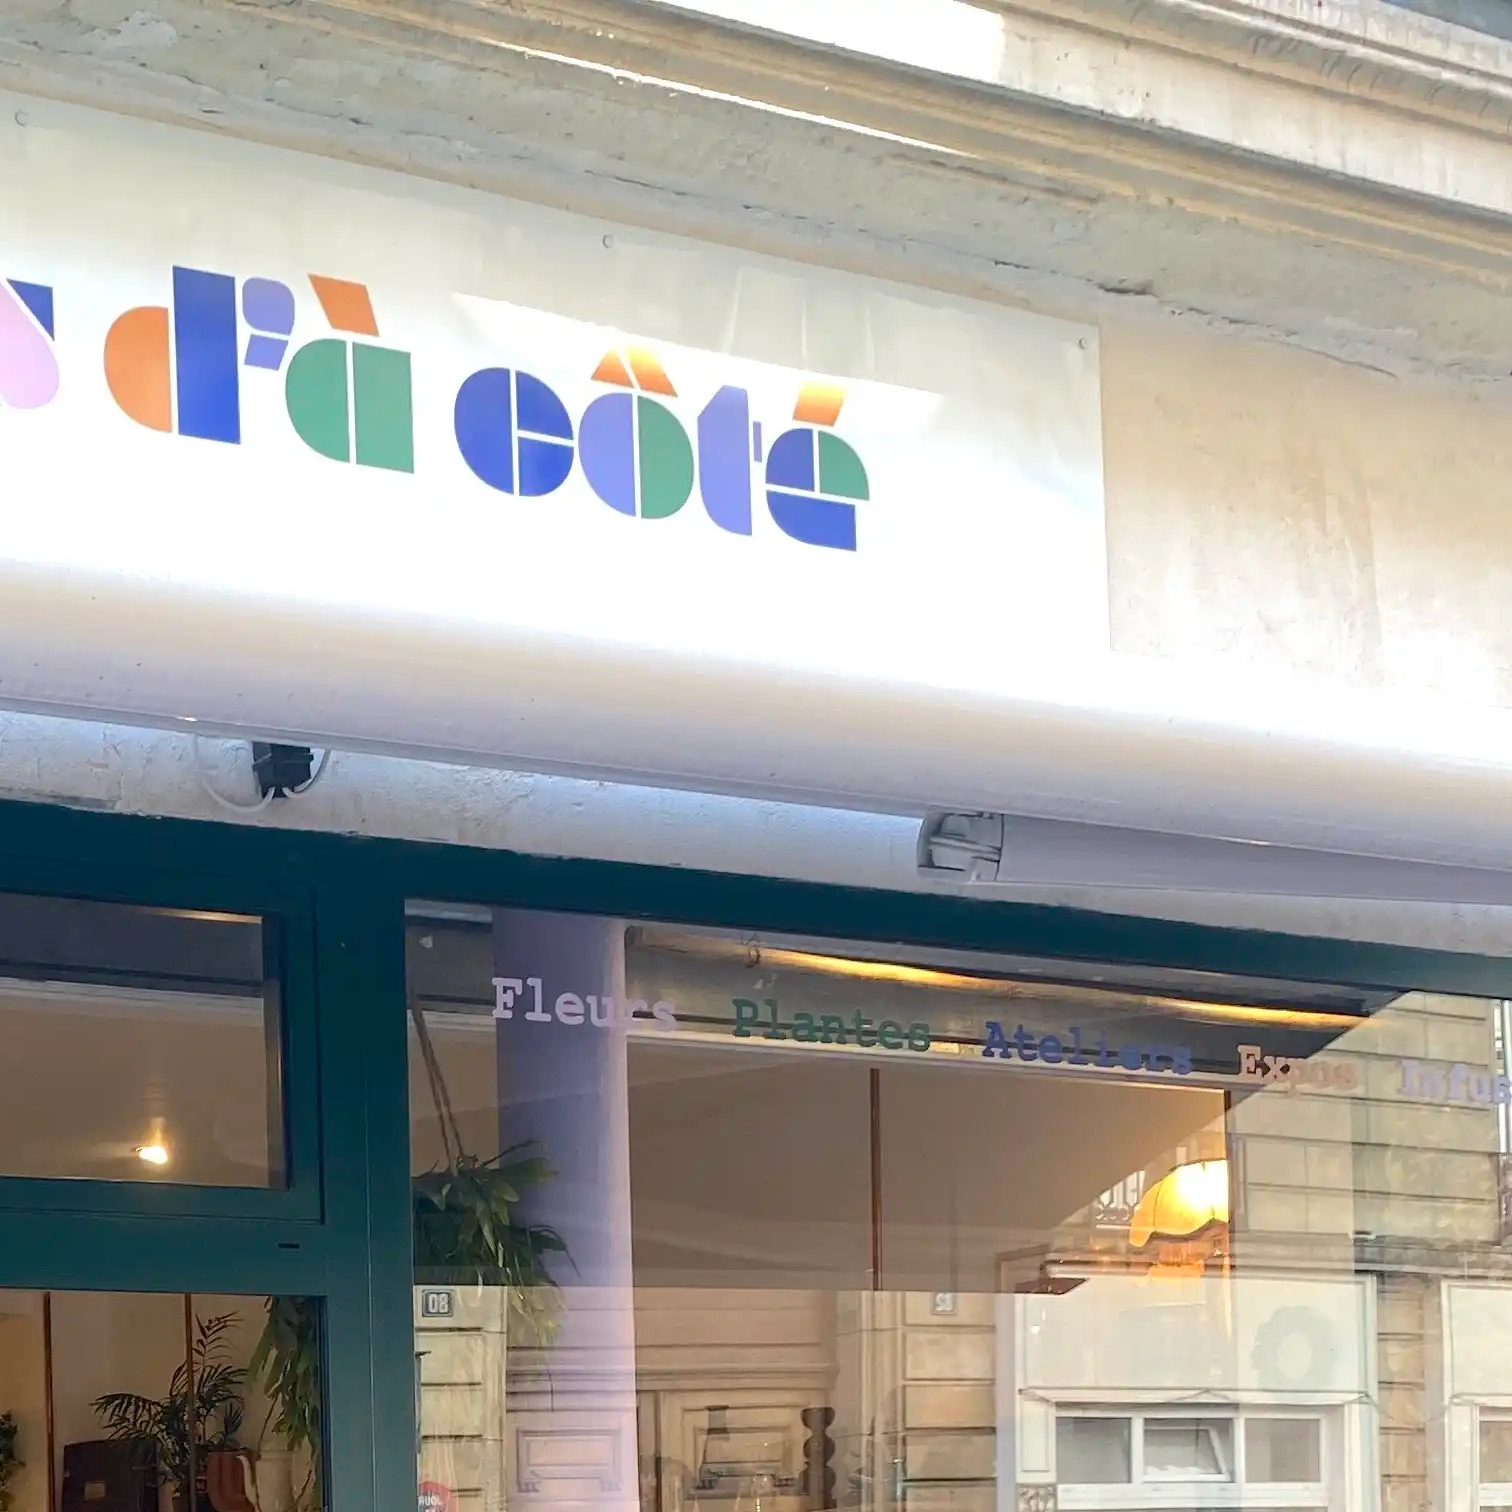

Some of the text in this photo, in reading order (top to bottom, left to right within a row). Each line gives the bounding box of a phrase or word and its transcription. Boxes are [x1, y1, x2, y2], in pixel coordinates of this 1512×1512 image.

[102, 264, 415, 475] d'à
[453, 344, 871, 553] côté
[490, 976, 678, 1033] Fleurs
[732, 998, 932, 1053] Plantes
[982, 1020, 1194, 1077] Ateliers
[1236, 1044, 1358, 1099] Expos
